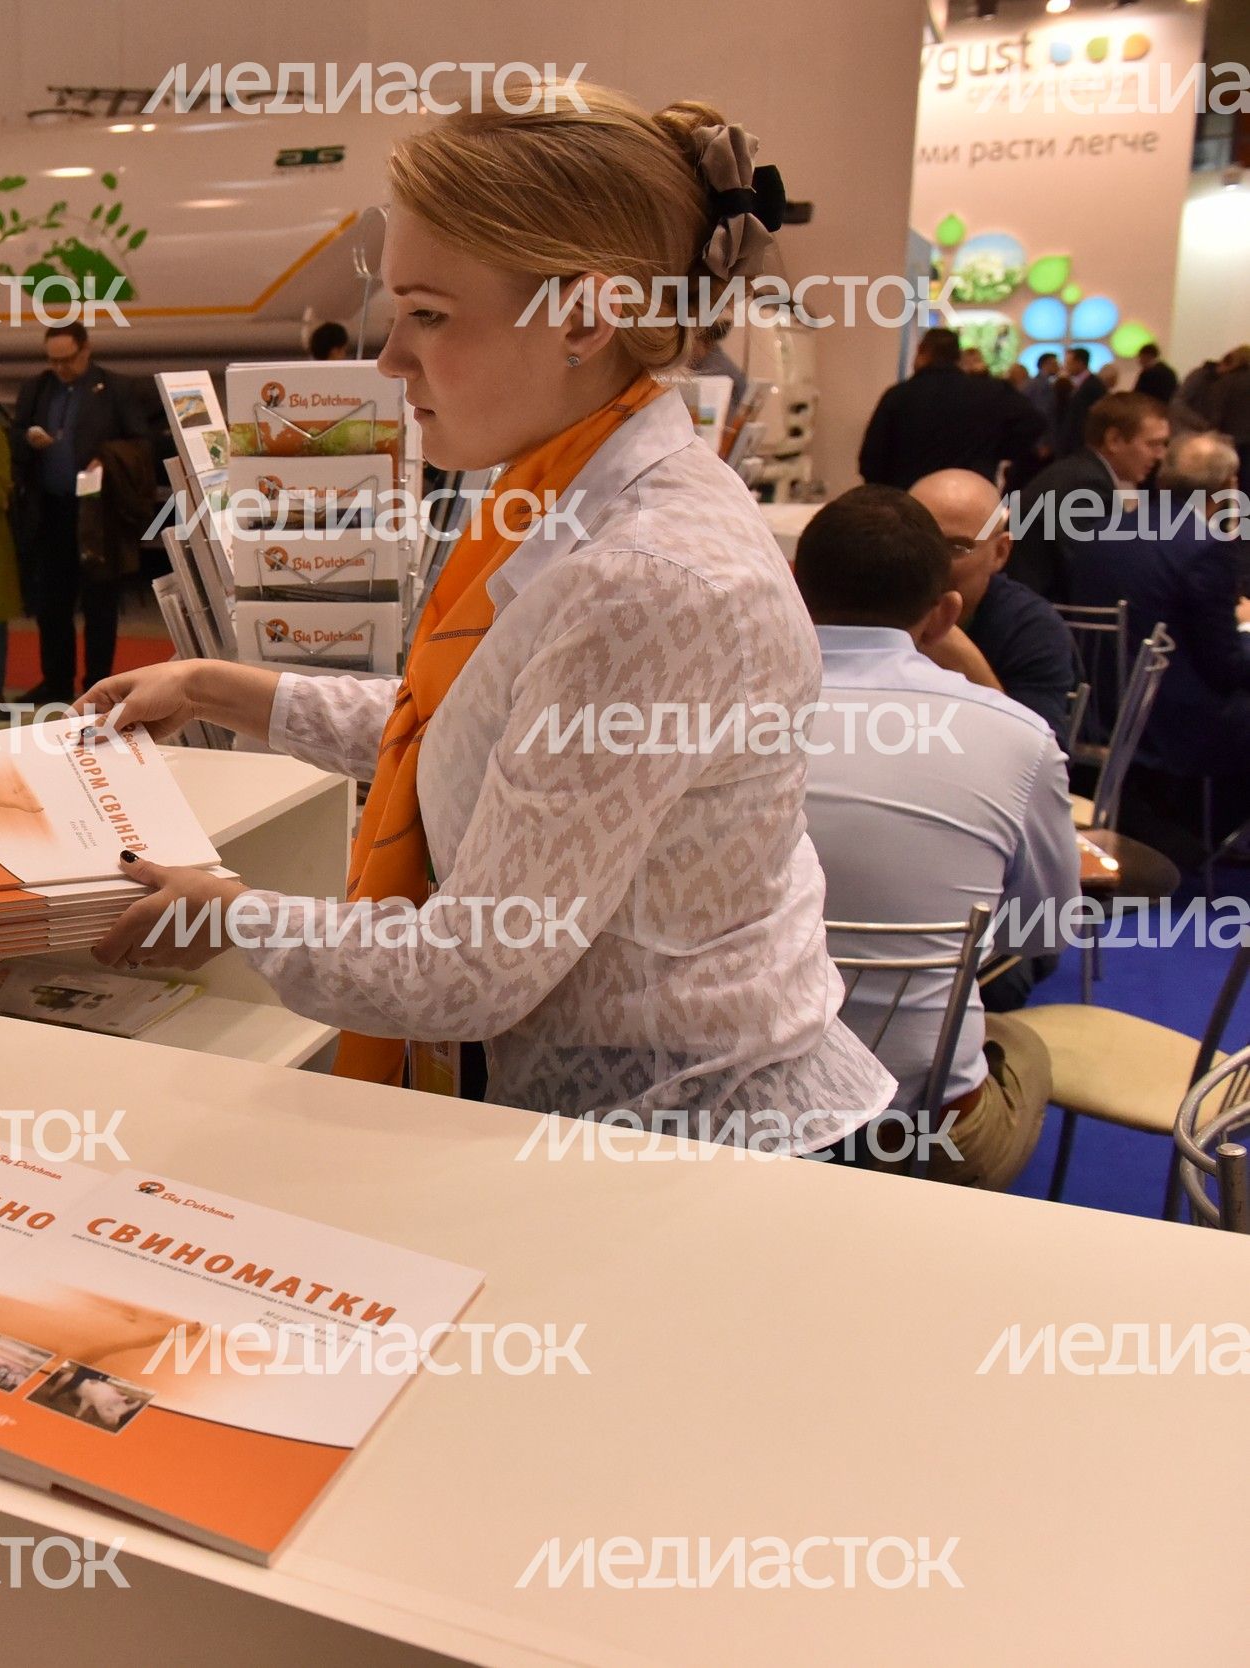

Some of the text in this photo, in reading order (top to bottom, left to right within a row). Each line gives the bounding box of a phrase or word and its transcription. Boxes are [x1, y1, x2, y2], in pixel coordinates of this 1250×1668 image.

[968, 138, 1056, 168] расти
[1064, 131, 1160, 157] легче
[289, 393, 362, 409] Big Dutchman
[292, 557, 312, 571] Big
[293, 630, 312, 643] Big
[65, 731, 110, 790] ОКОРМ
[98, 794, 148, 853] СВИНЕЙ
[161, 1192, 236, 1220] Big Dutchman
[86, 1217, 398, 1327] СВИНОМАТКИ
